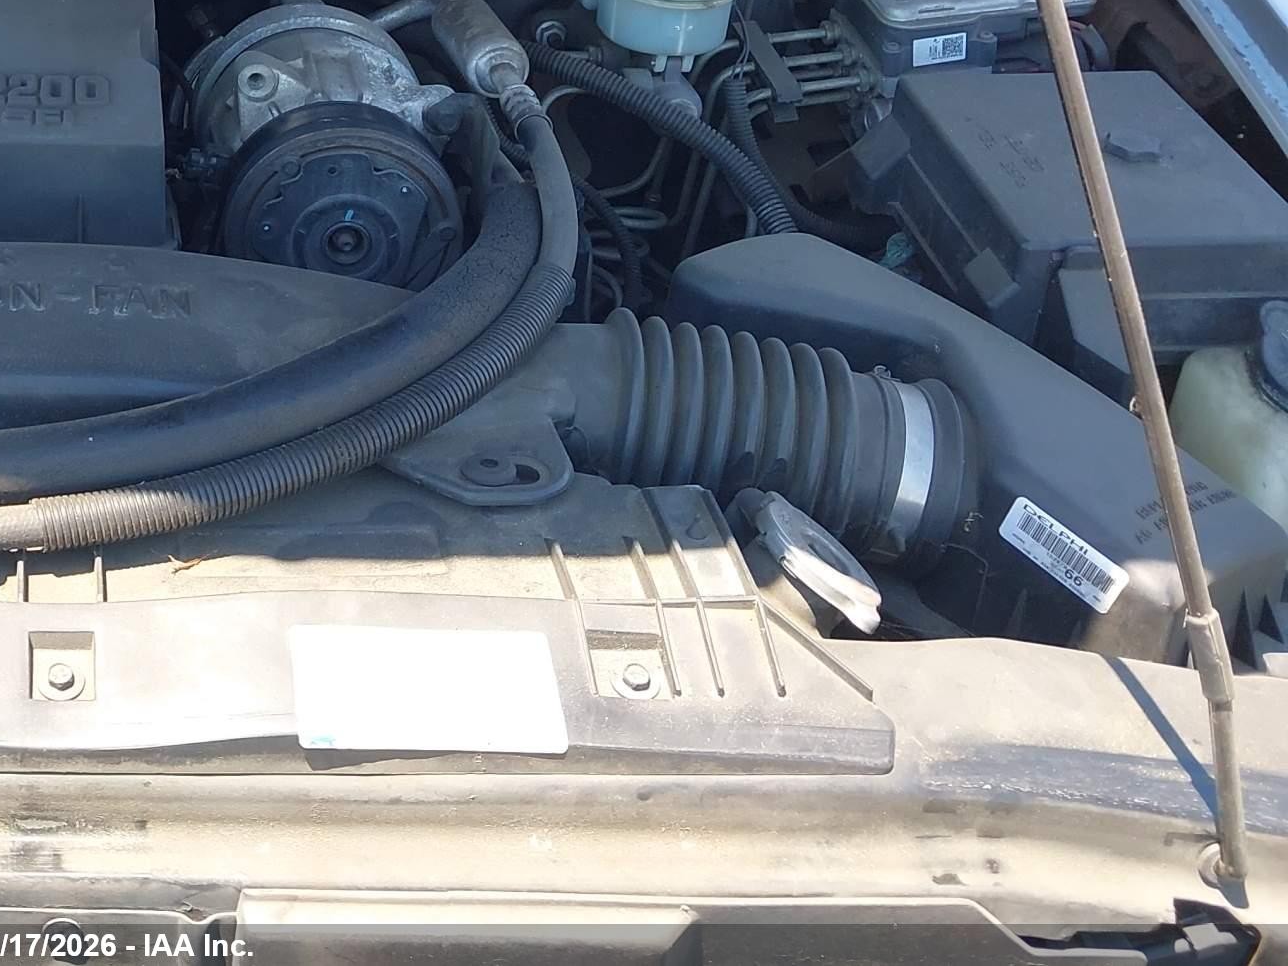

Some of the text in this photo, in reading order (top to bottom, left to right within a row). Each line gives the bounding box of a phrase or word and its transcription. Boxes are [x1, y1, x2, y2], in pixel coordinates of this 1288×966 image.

[1, 108, 73, 126] SFI
[87, 284, 192, 319] FAN
[1023, 504, 1089, 556] DELPHI
[1064, 569, 1083, 586] 66
